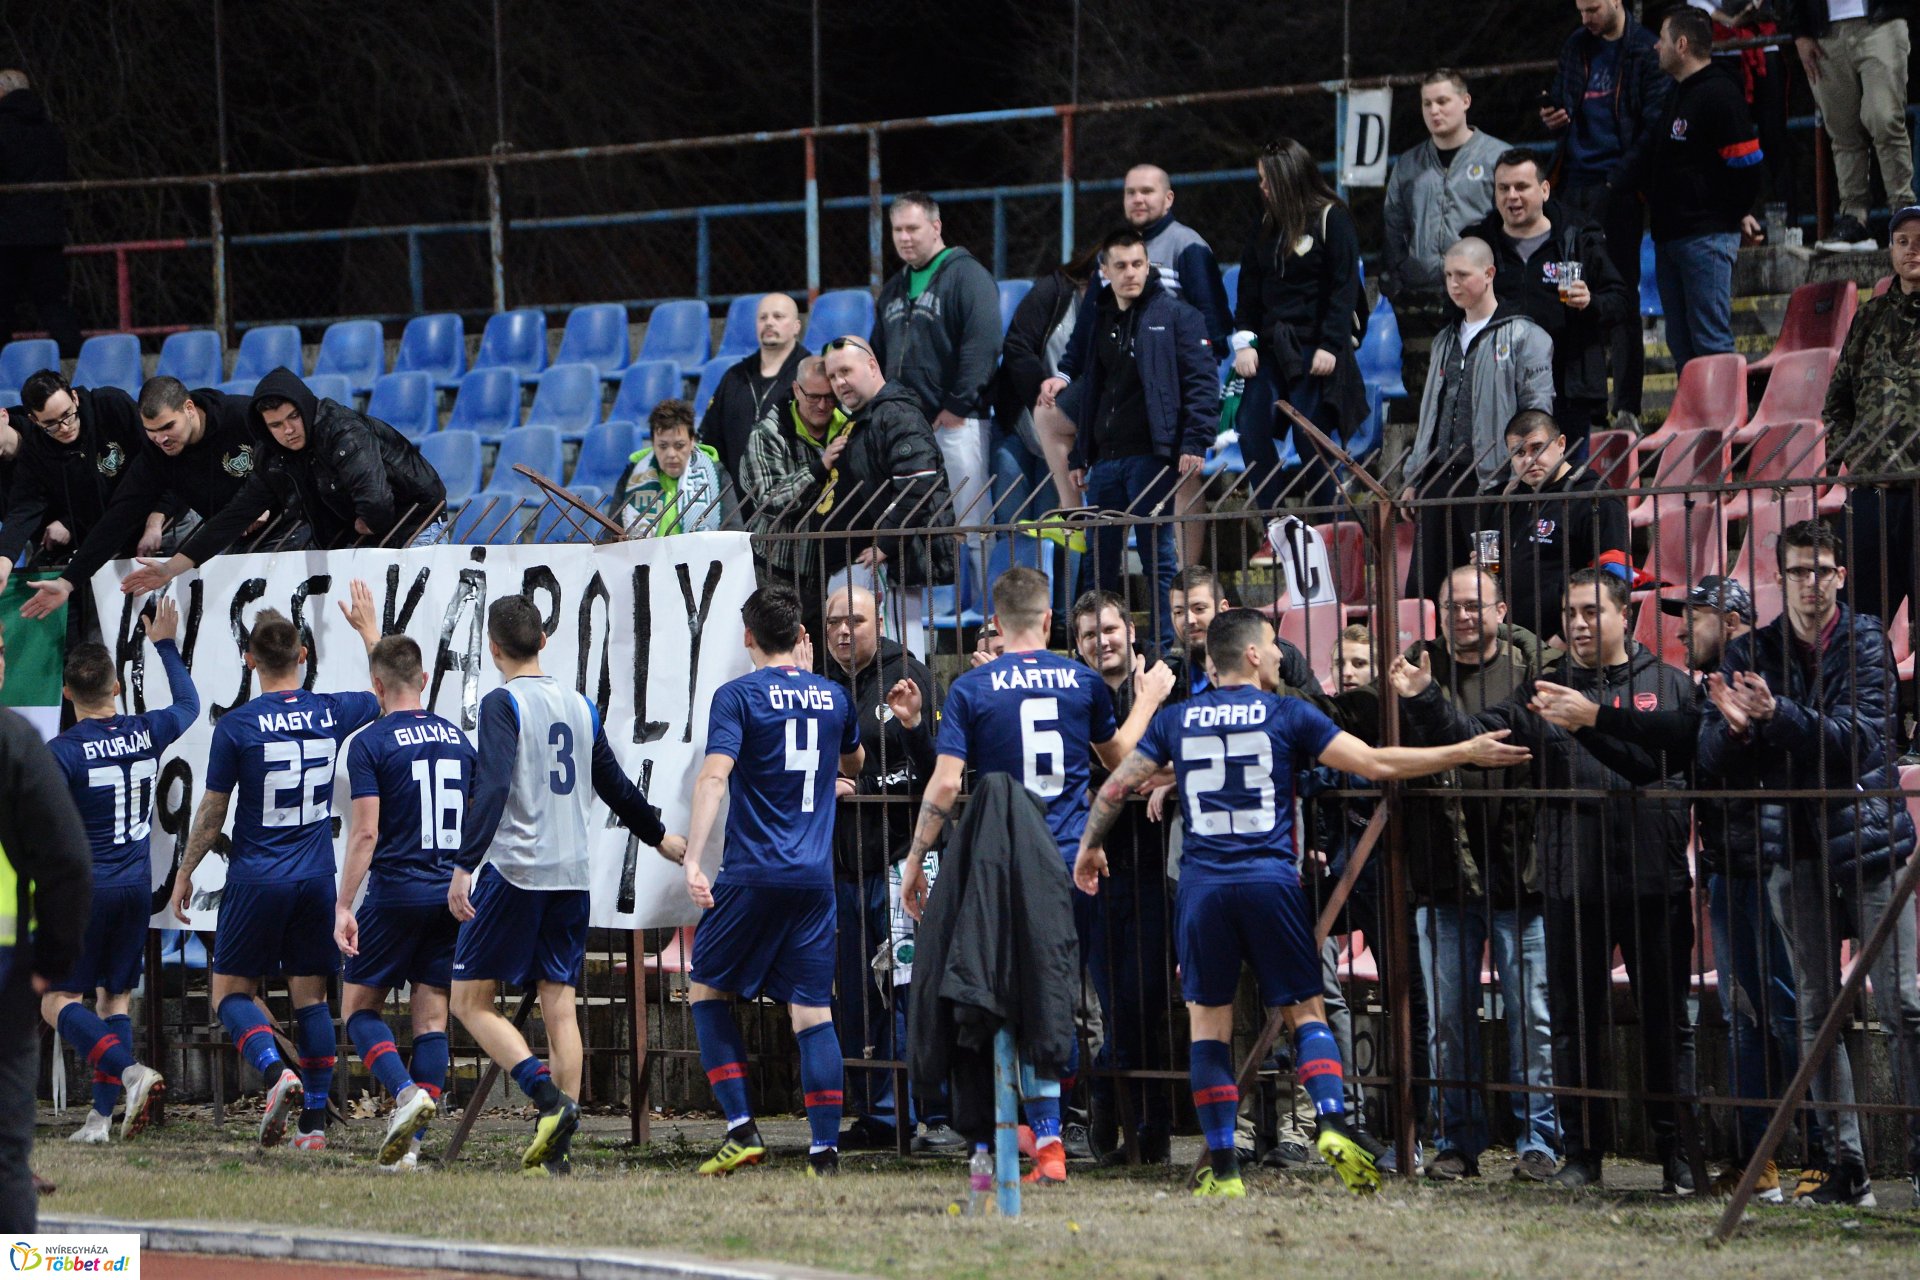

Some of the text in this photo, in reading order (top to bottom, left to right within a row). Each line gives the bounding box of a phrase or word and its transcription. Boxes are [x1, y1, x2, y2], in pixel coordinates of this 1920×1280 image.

[1352, 112, 1385, 166] D
[258, 711, 313, 732] NAGY
[769, 684, 834, 710] ÖTVÖS
[262, 737, 337, 827] 22
[548, 721, 576, 795] 3
[785, 718, 820, 812] 4
[1020, 697, 1065, 797] 6
[1181, 730, 1276, 836] 23
[88, 757, 157, 844] 70
[411, 758, 464, 850] 16
